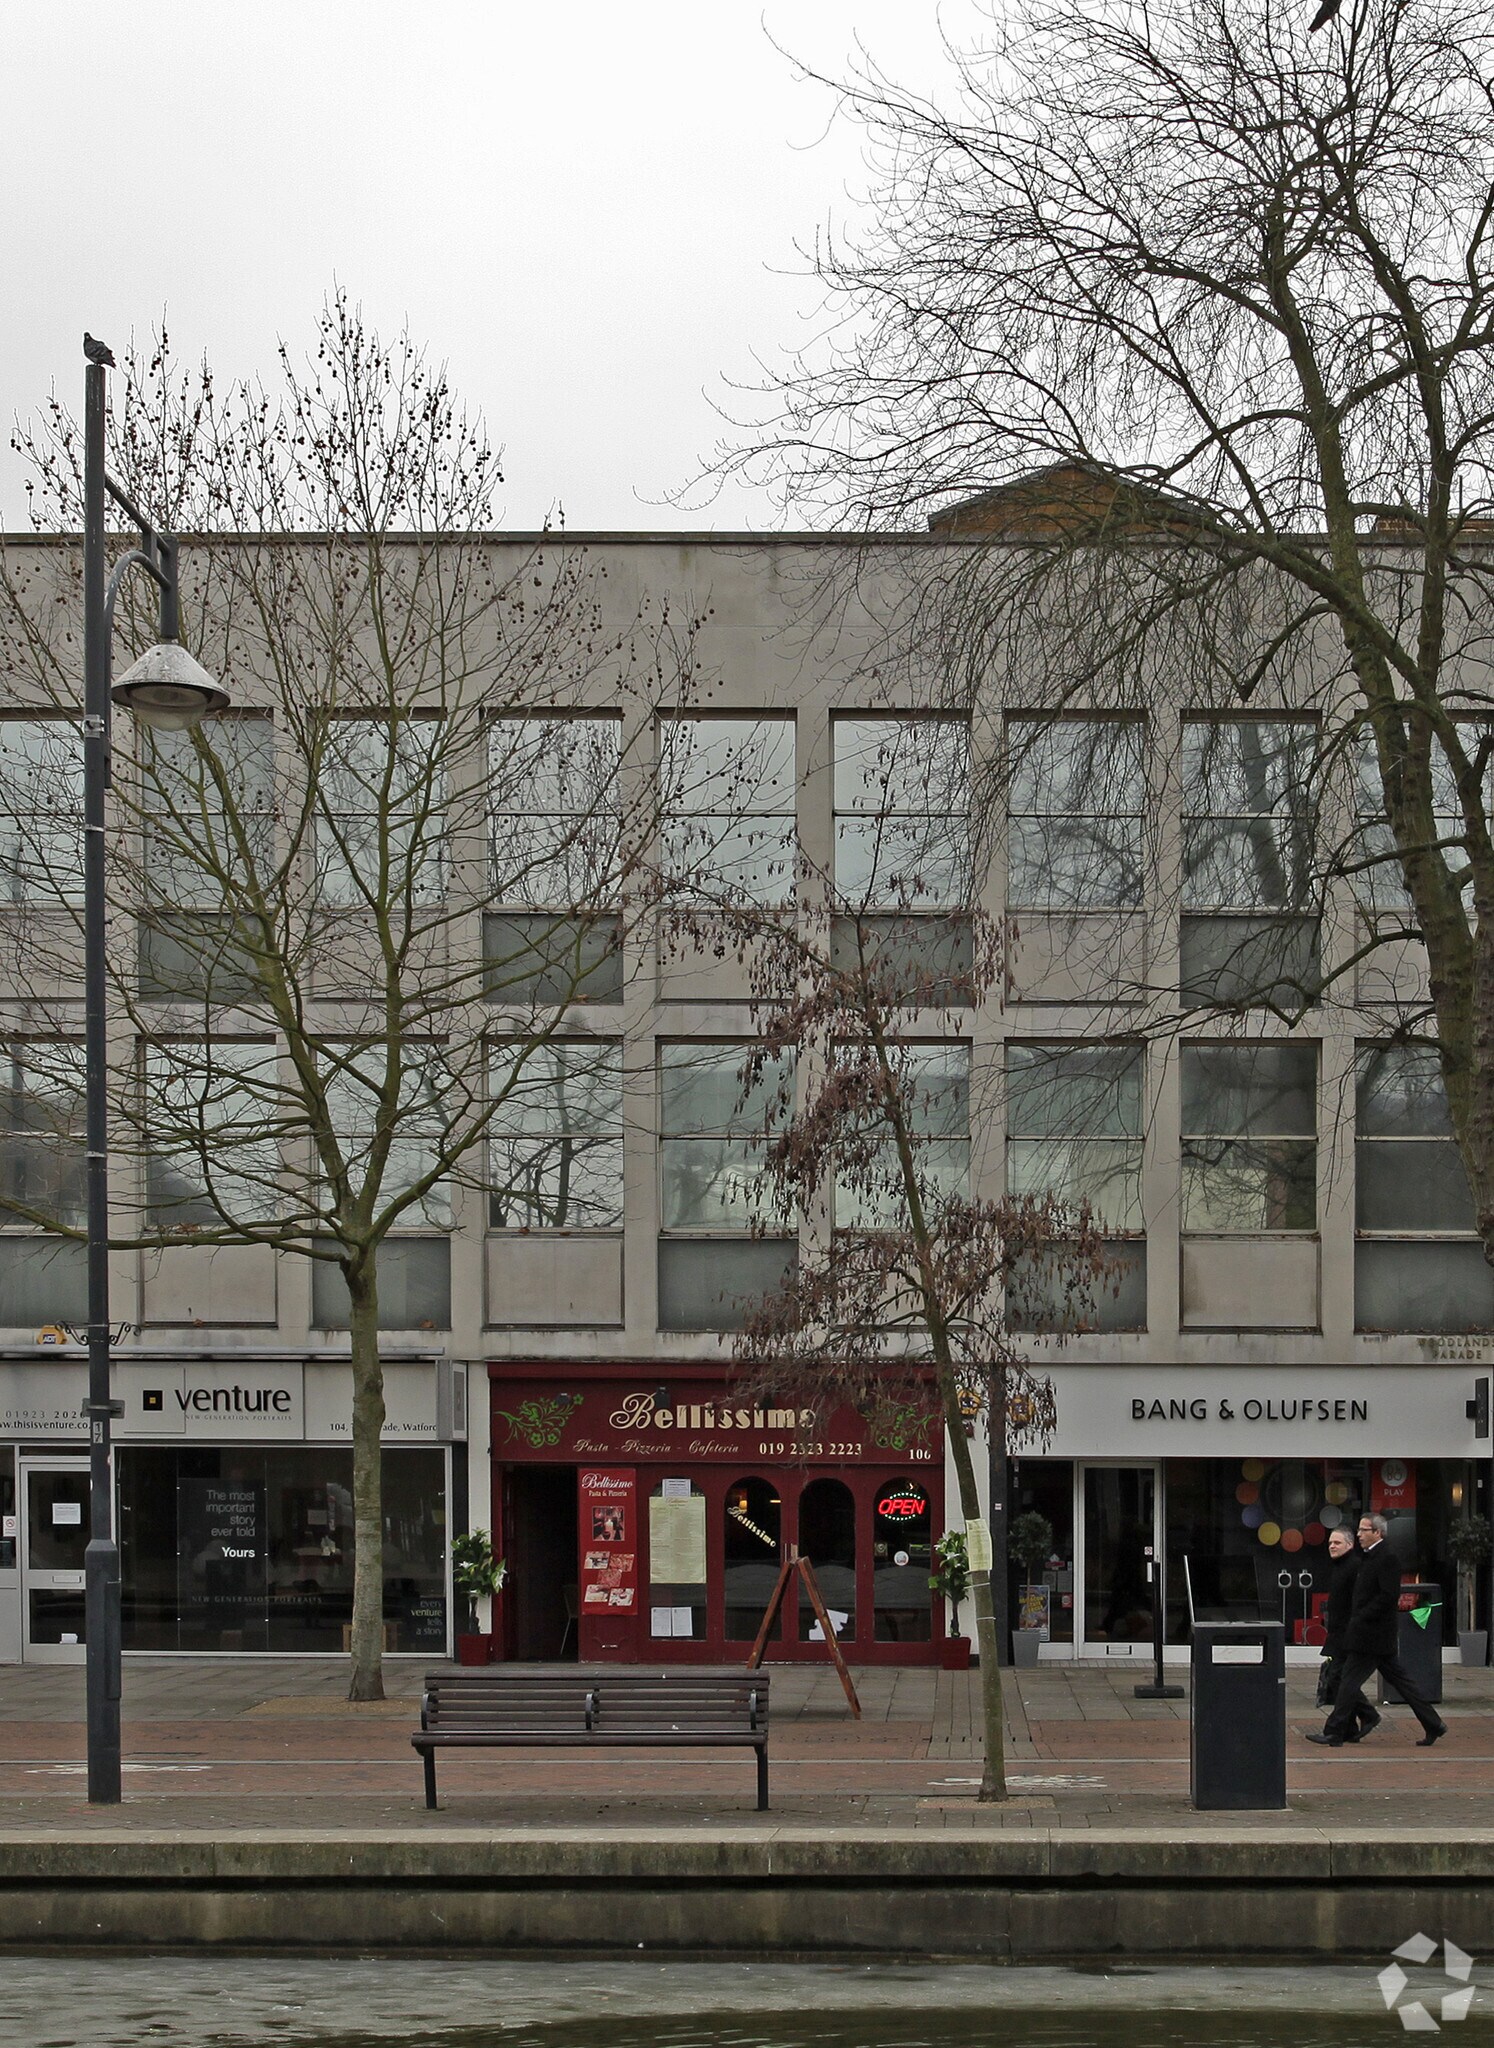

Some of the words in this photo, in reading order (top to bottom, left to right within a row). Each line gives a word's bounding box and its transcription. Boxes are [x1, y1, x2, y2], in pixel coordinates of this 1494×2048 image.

[174, 1385, 292, 1413] venture
[5, 1410, 46, 1419] 01923
[609, 1392, 817, 1430] Bellissimo
[1131, 1398, 1207, 1420] BANG
[1218, 1398, 1235, 1420] &
[1243, 1399, 1368, 1421] OLUFSEN
[572, 1438, 609, 1453] Pasta
[621, 1439, 672, 1455] Pizzeria
[688, 1439, 739, 1456] Cafeteria
[759, 1442, 785, 1455] 019
[829, 1442, 862, 1455] 2223
[908, 1449, 931, 1460] 106
[582, 1473, 633, 1489] Bellissimo
[207, 1489, 226, 1501] The
[229, 1490, 255, 1501] most
[1384, 1488, 1405, 1497] PLAY
[206, 1503, 255, 1514] important
[878, 1498, 926, 1515] OPEN
[230, 1516, 256, 1526] story
[727, 1506, 777, 1548] Bellissimo
[211, 1527, 233, 1537] ever
[236, 1526, 256, 1537] told
[222, 1546, 256, 1558] Yours
[410, 1608, 443, 1617] venture
